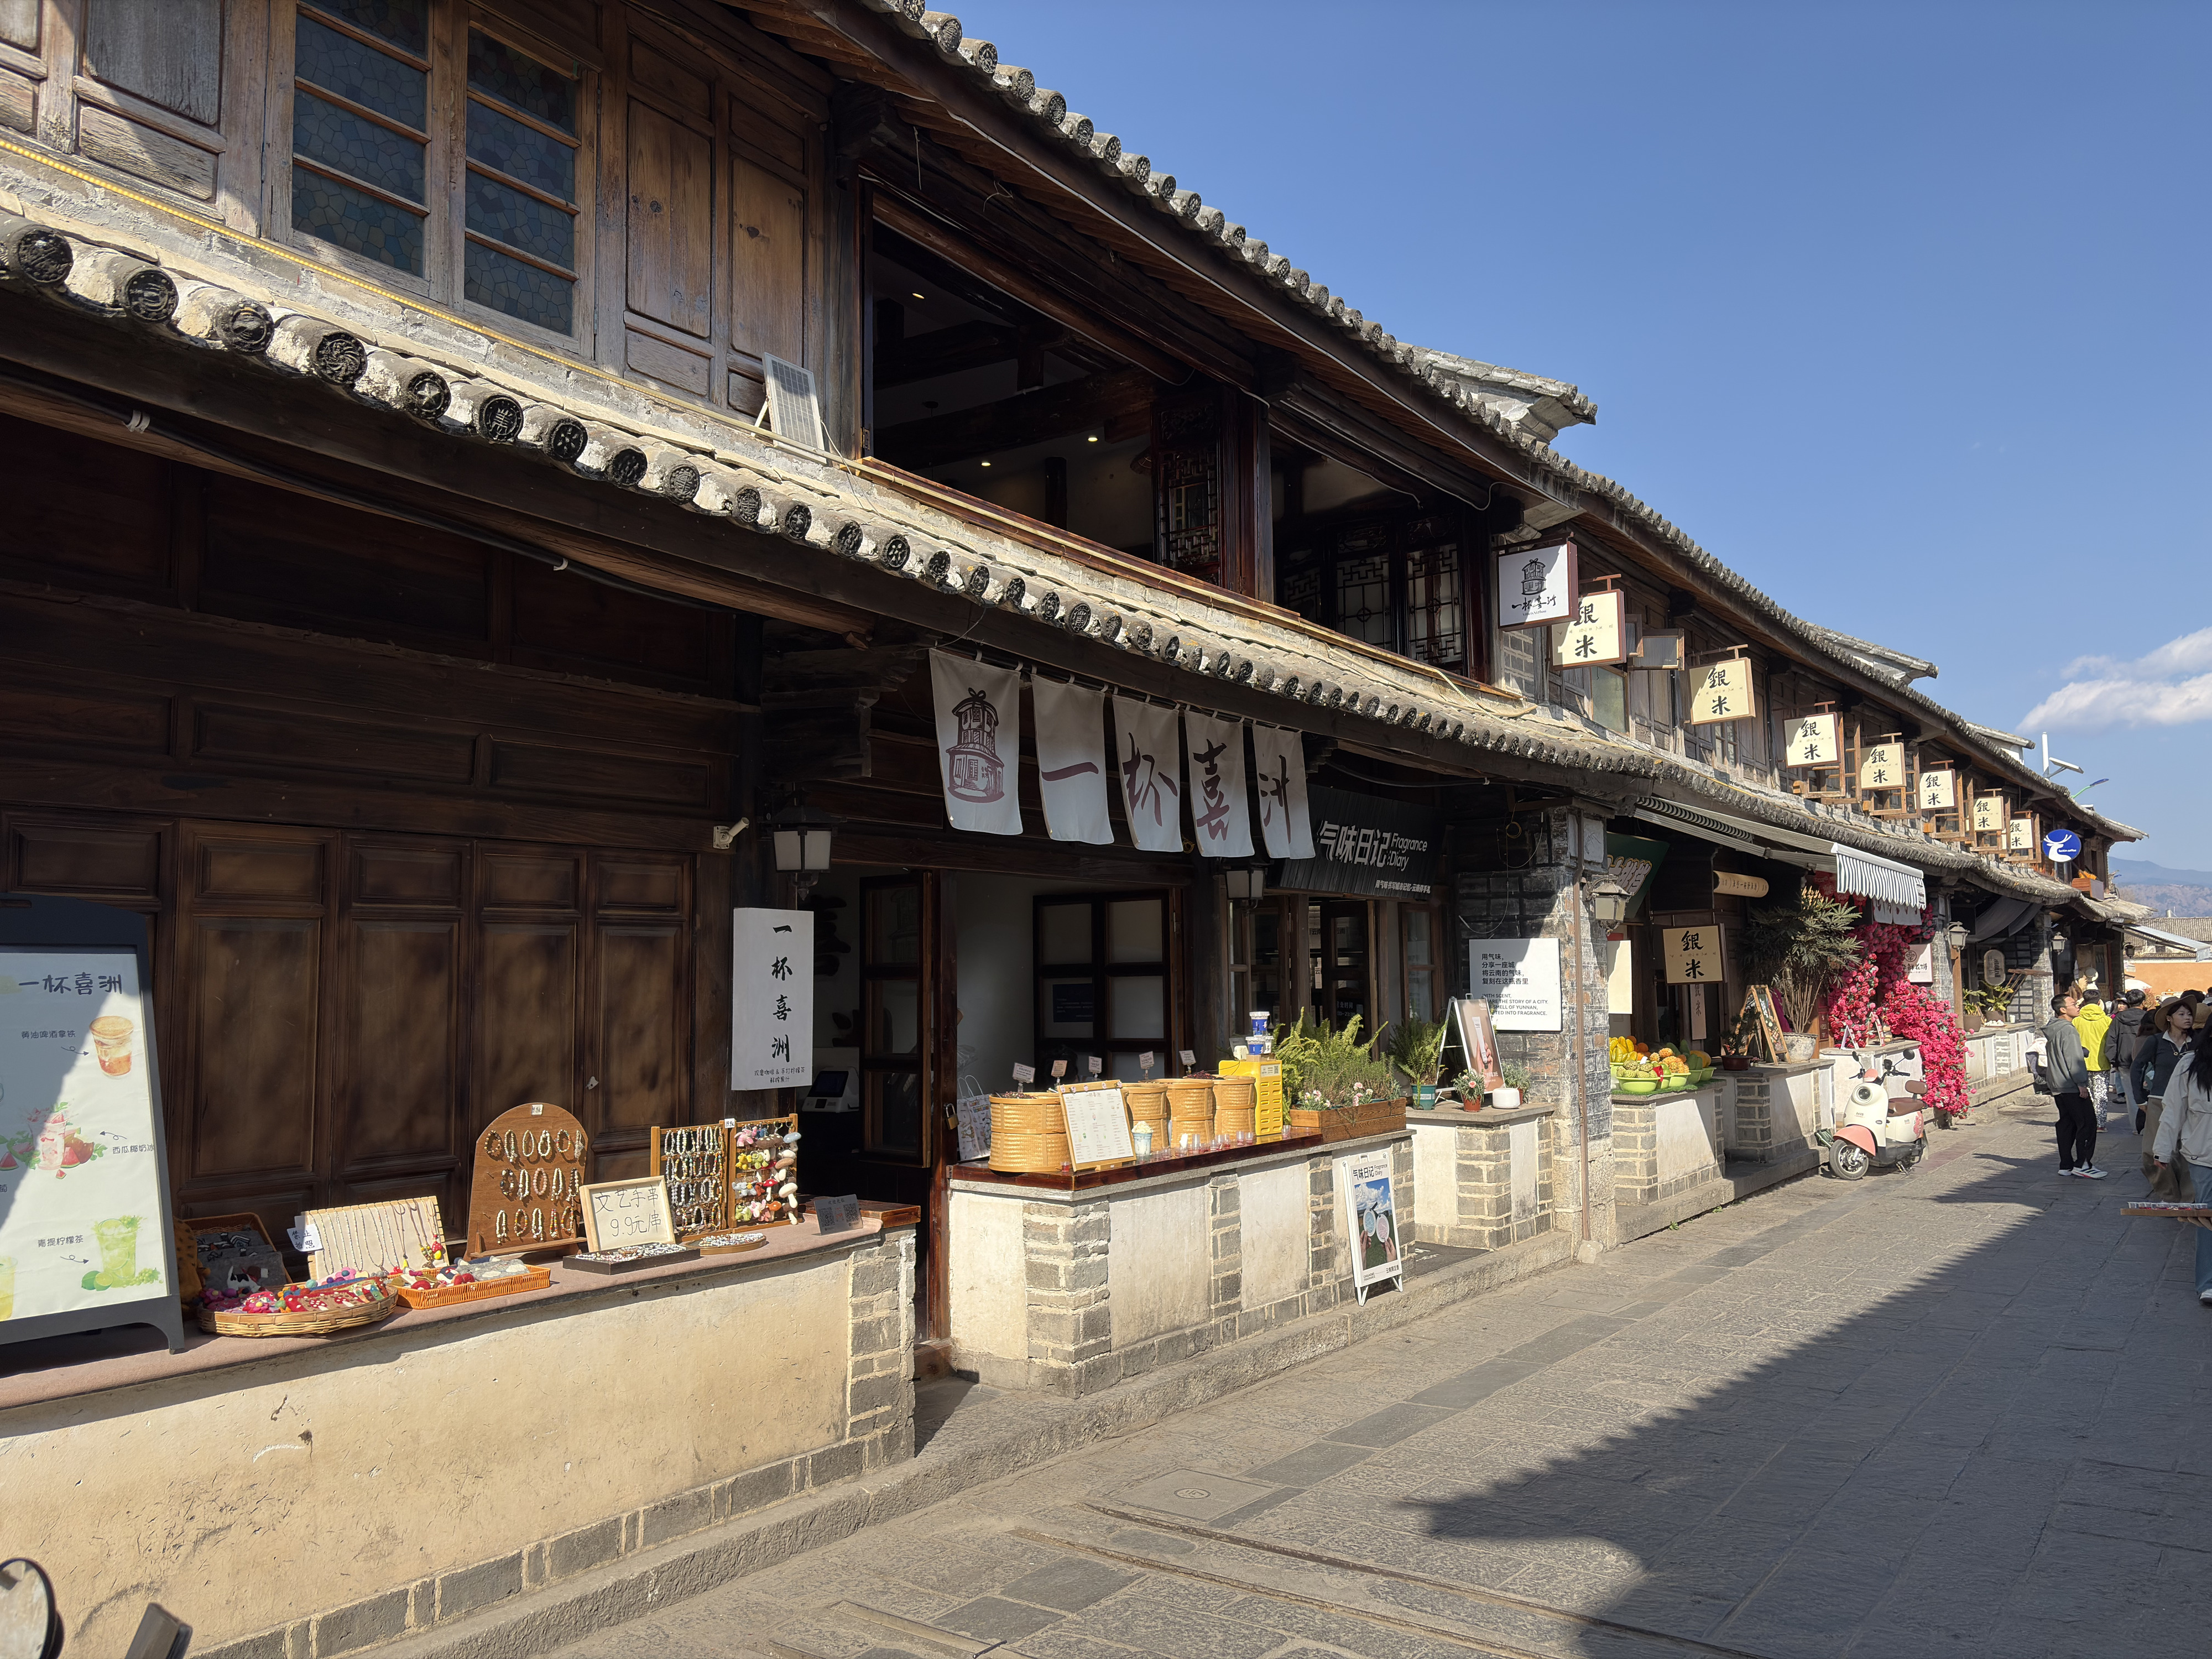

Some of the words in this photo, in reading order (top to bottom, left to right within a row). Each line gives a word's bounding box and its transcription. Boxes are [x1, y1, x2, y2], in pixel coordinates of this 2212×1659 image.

[1318, 821, 1391, 867] 气味日记
[1391, 833, 1427, 853] Fragrance
[1682, 930, 1705, 979] 銀米
[18, 972, 122, 995] 一杯喜洲
[771, 925, 793, 1063] 一杯喜洲
[21, 1030, 76, 1039] 黄油啤酒拿铁
[1353, 1166, 1375, 1181] 气味日记
[594, 1184, 659, 1214] 文艺手串
[610, 1209, 661, 1237] 9.9元/串
[37, 1234, 84, 1248] 青提柠檬茶
[291, 1230, 312, 1240] 禁止
